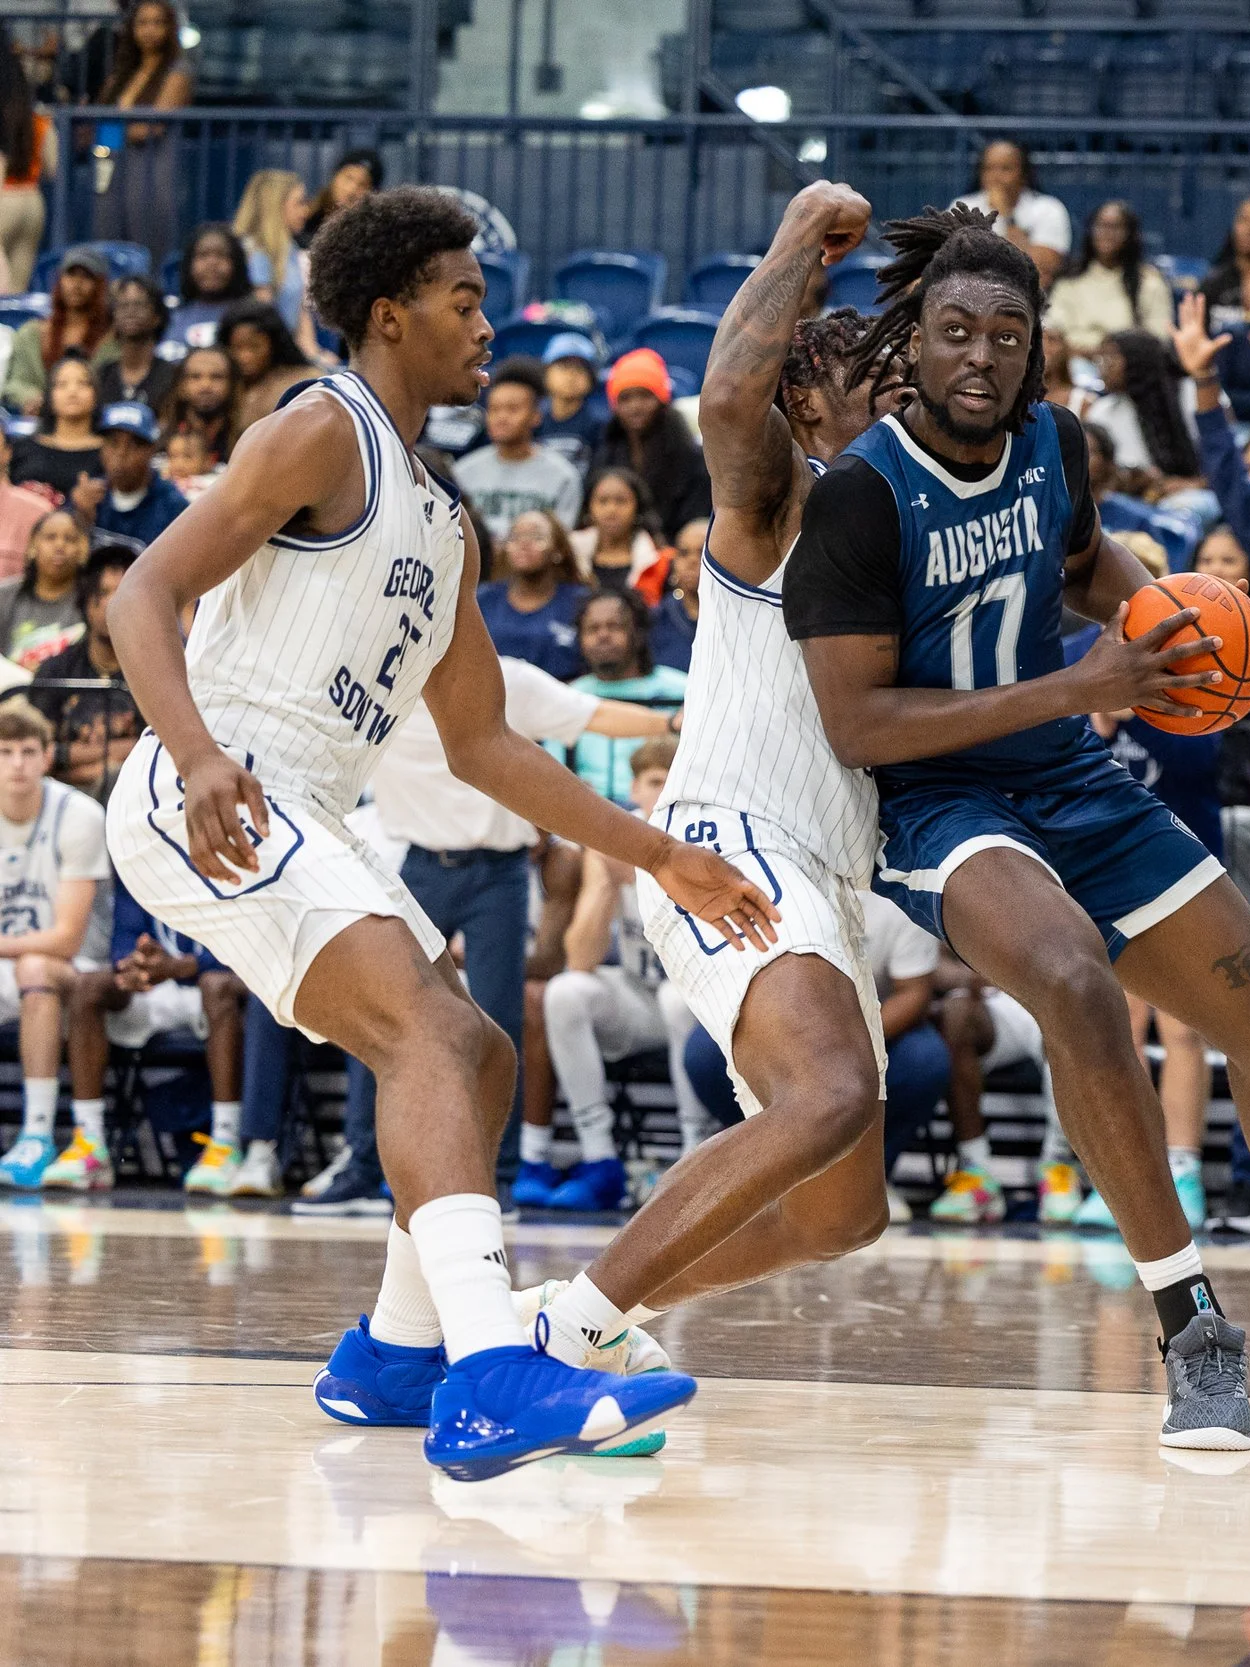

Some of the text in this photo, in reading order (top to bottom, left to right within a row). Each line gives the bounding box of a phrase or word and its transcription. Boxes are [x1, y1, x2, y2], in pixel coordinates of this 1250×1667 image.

[924, 495, 1044, 588] AUGUSTA
[384, 557, 434, 621] GEOR
[943, 571, 1026, 690] 17
